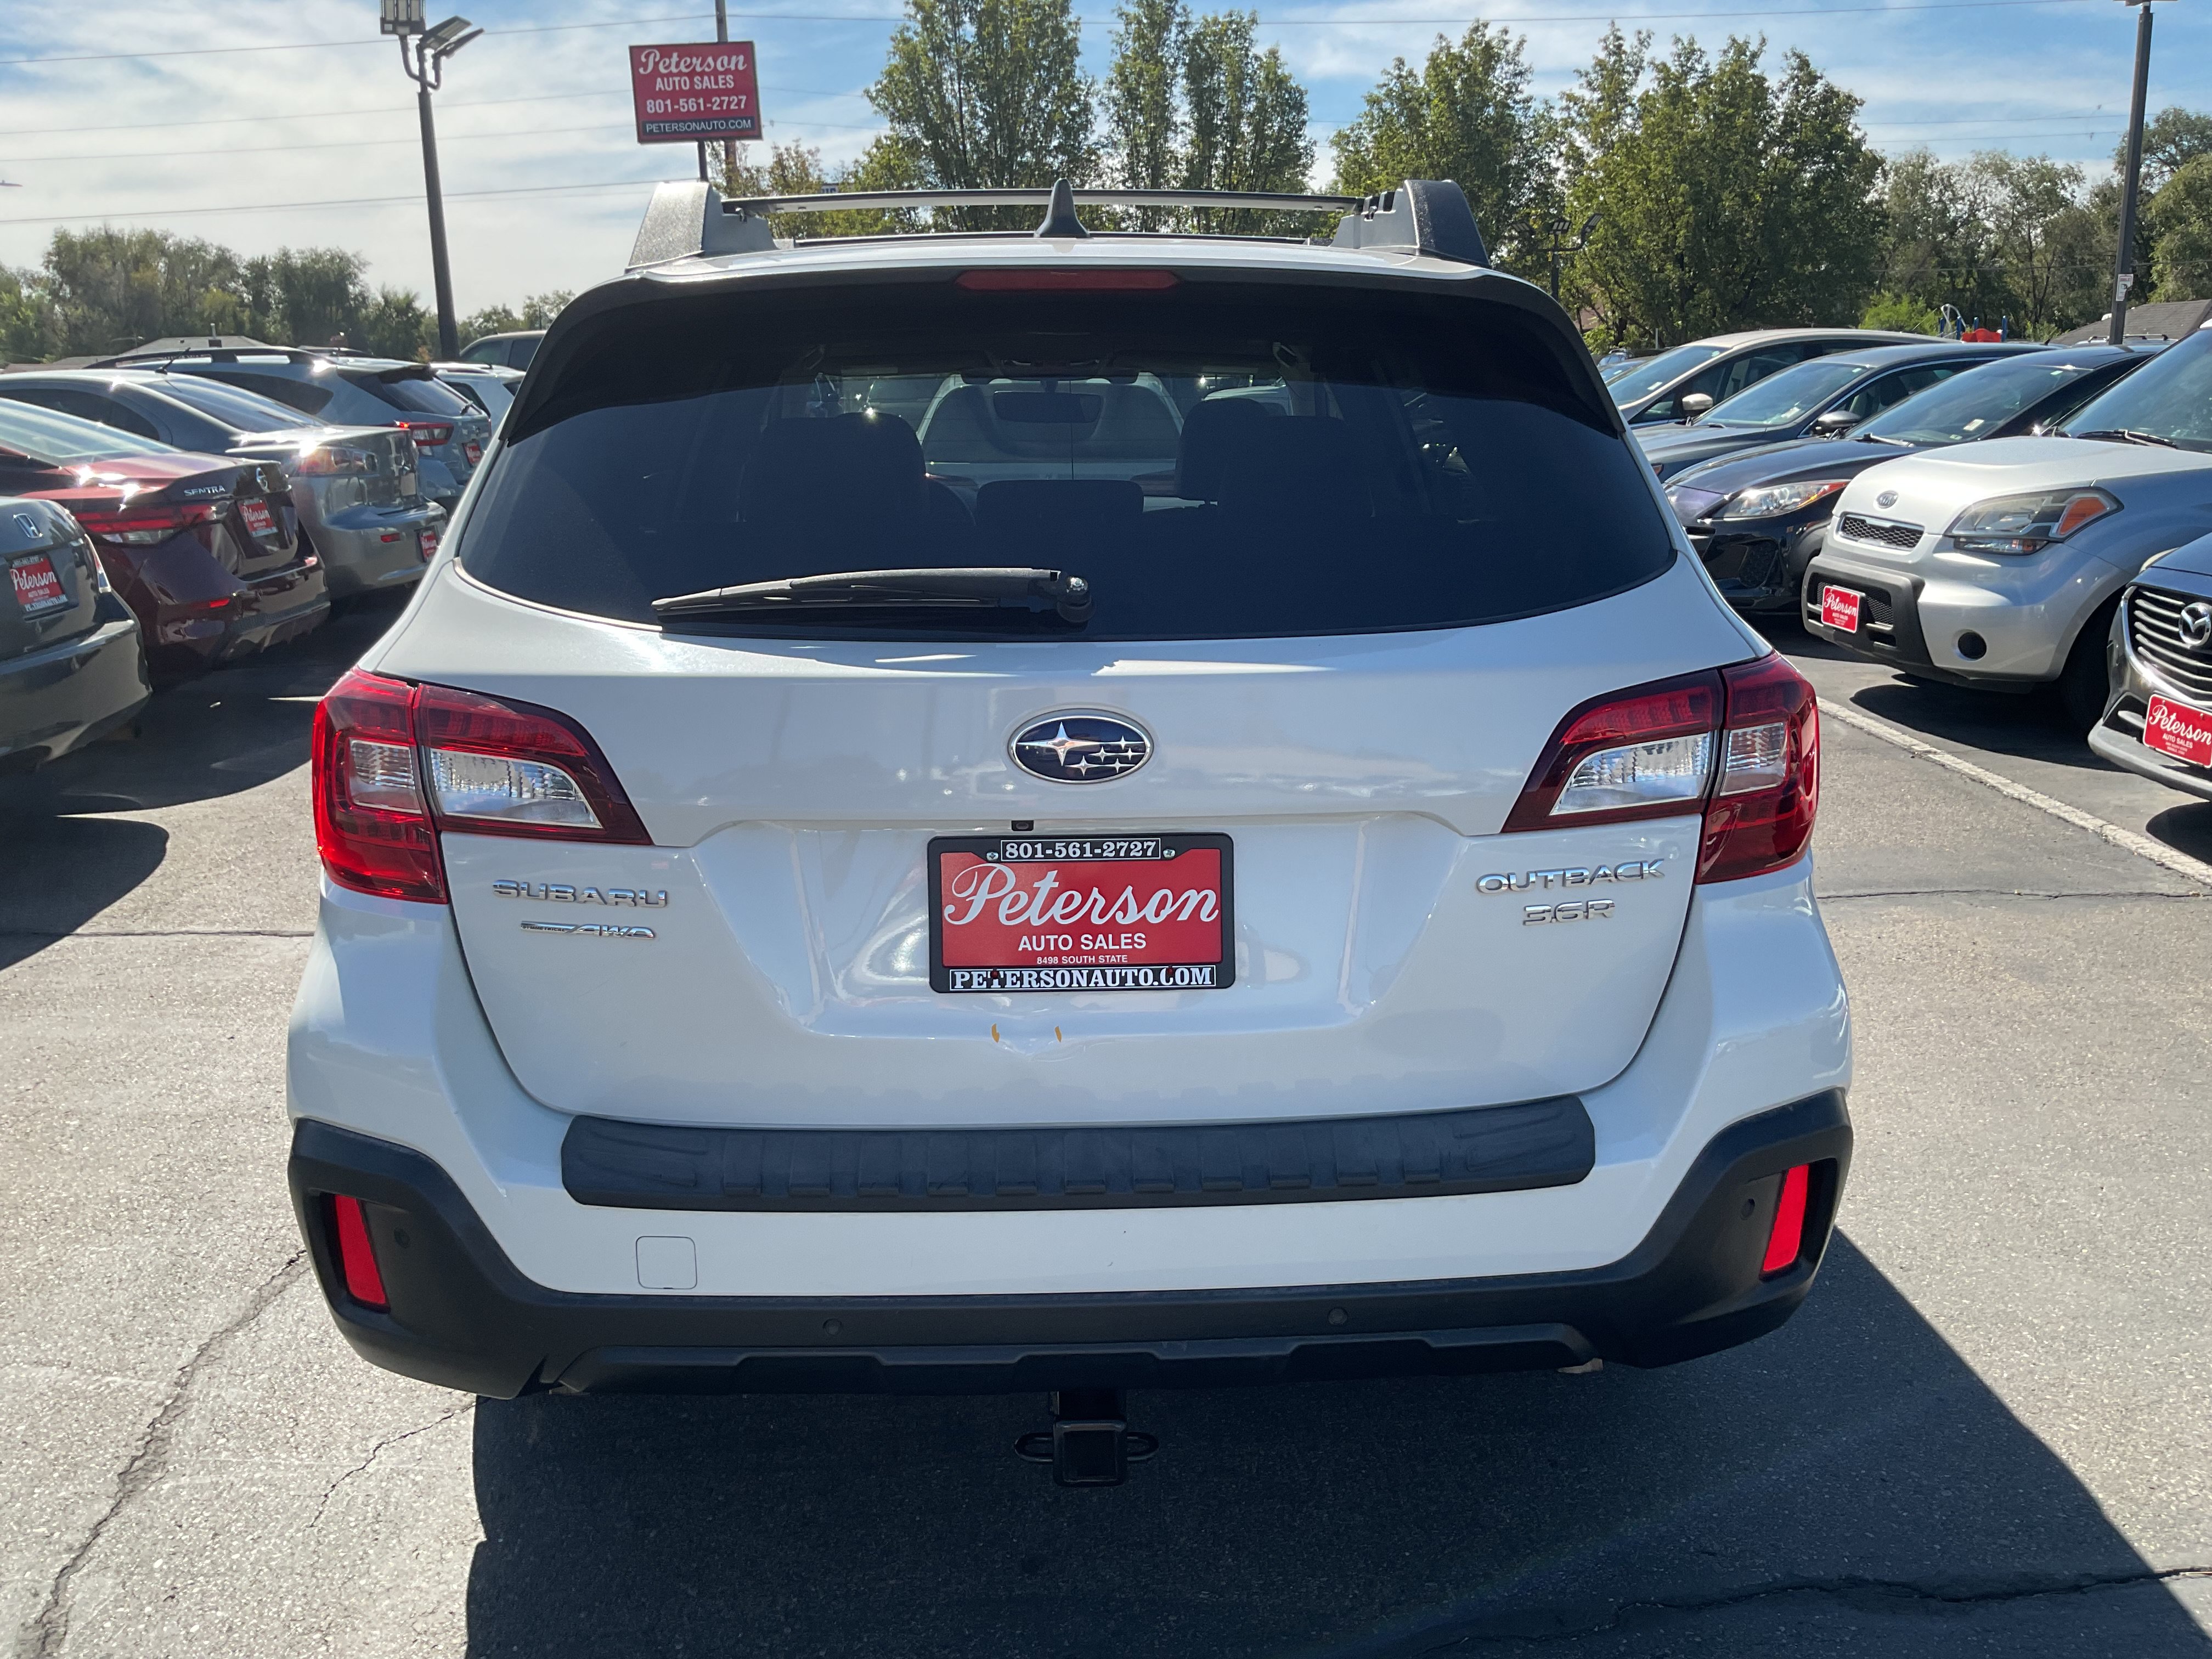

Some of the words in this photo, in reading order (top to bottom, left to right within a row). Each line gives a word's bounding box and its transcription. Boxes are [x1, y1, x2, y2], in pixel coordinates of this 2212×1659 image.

[639, 49, 747, 75] Peterson
[656, 76, 690, 91] AUTO
[693, 75, 734, 90] SALES
[646, 95, 747, 114] 801-561-2727
[646, 119, 751, 133] PETERSONAUTO.COM
[184, 485, 225, 496] SENTRA
[9, 569, 57, 591] Peterson
[1824, 592, 1857, 617] Peterson
[2149, 705, 2211, 745] Peterson
[2162, 733, 2176, 743] AUTO
[2176, 738, 2193, 749] SALES
[1005, 841, 1156, 859] 801-561-2727
[1476, 858, 1666, 894] OUTBACK
[493, 879, 668, 908] SUBARU
[944, 863, 1219, 926] Peterson
[1523, 899, 1616, 926] 3.6R
[576, 923, 655, 939] AWD
[1018, 934, 1073, 951] AUTO
[1080, 933, 1147, 950] SALES
[1036, 956, 1059, 964] 8498
[1062, 955, 1096, 964] SOUTH
[1098, 954, 1128, 963] STATE
[954, 966, 1212, 989] PETERSONAUTO.COM
